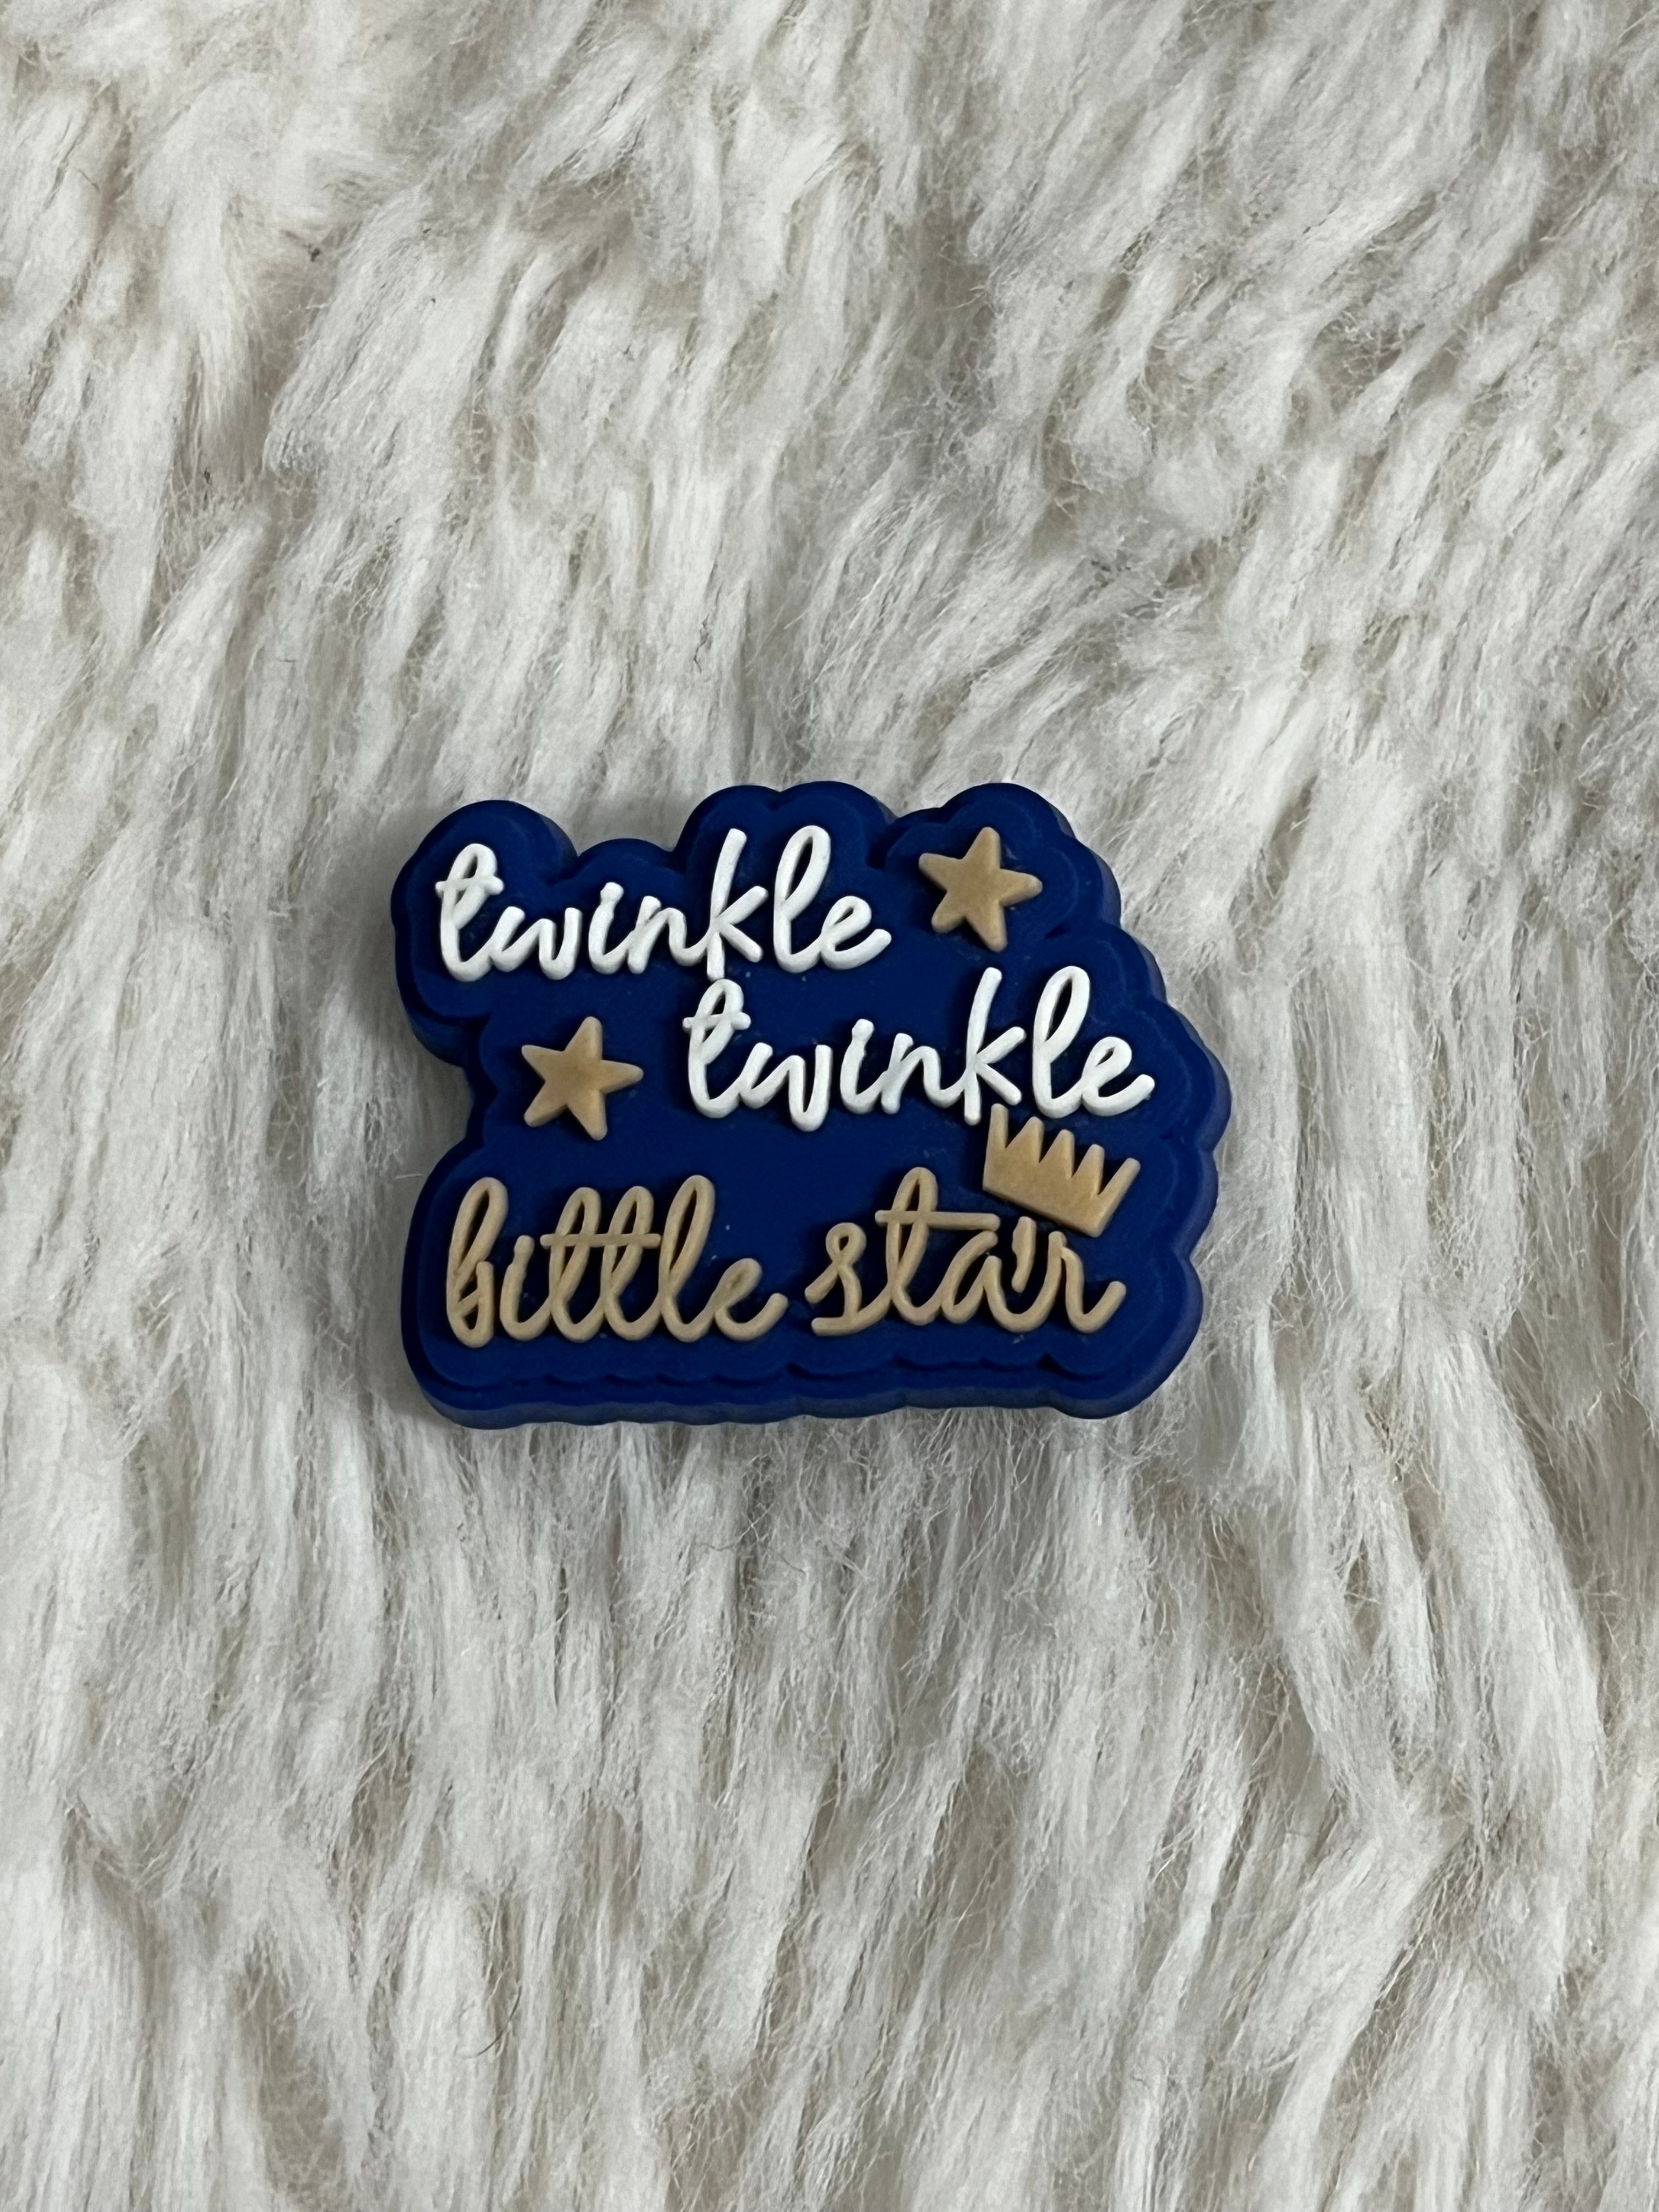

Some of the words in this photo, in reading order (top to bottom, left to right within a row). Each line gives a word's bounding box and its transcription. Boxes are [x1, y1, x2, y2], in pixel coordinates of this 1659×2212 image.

[435, 825, 892, 980] twinkle
[682, 966, 1155, 1132] twinkle
[804, 1166, 1127, 1336] star
